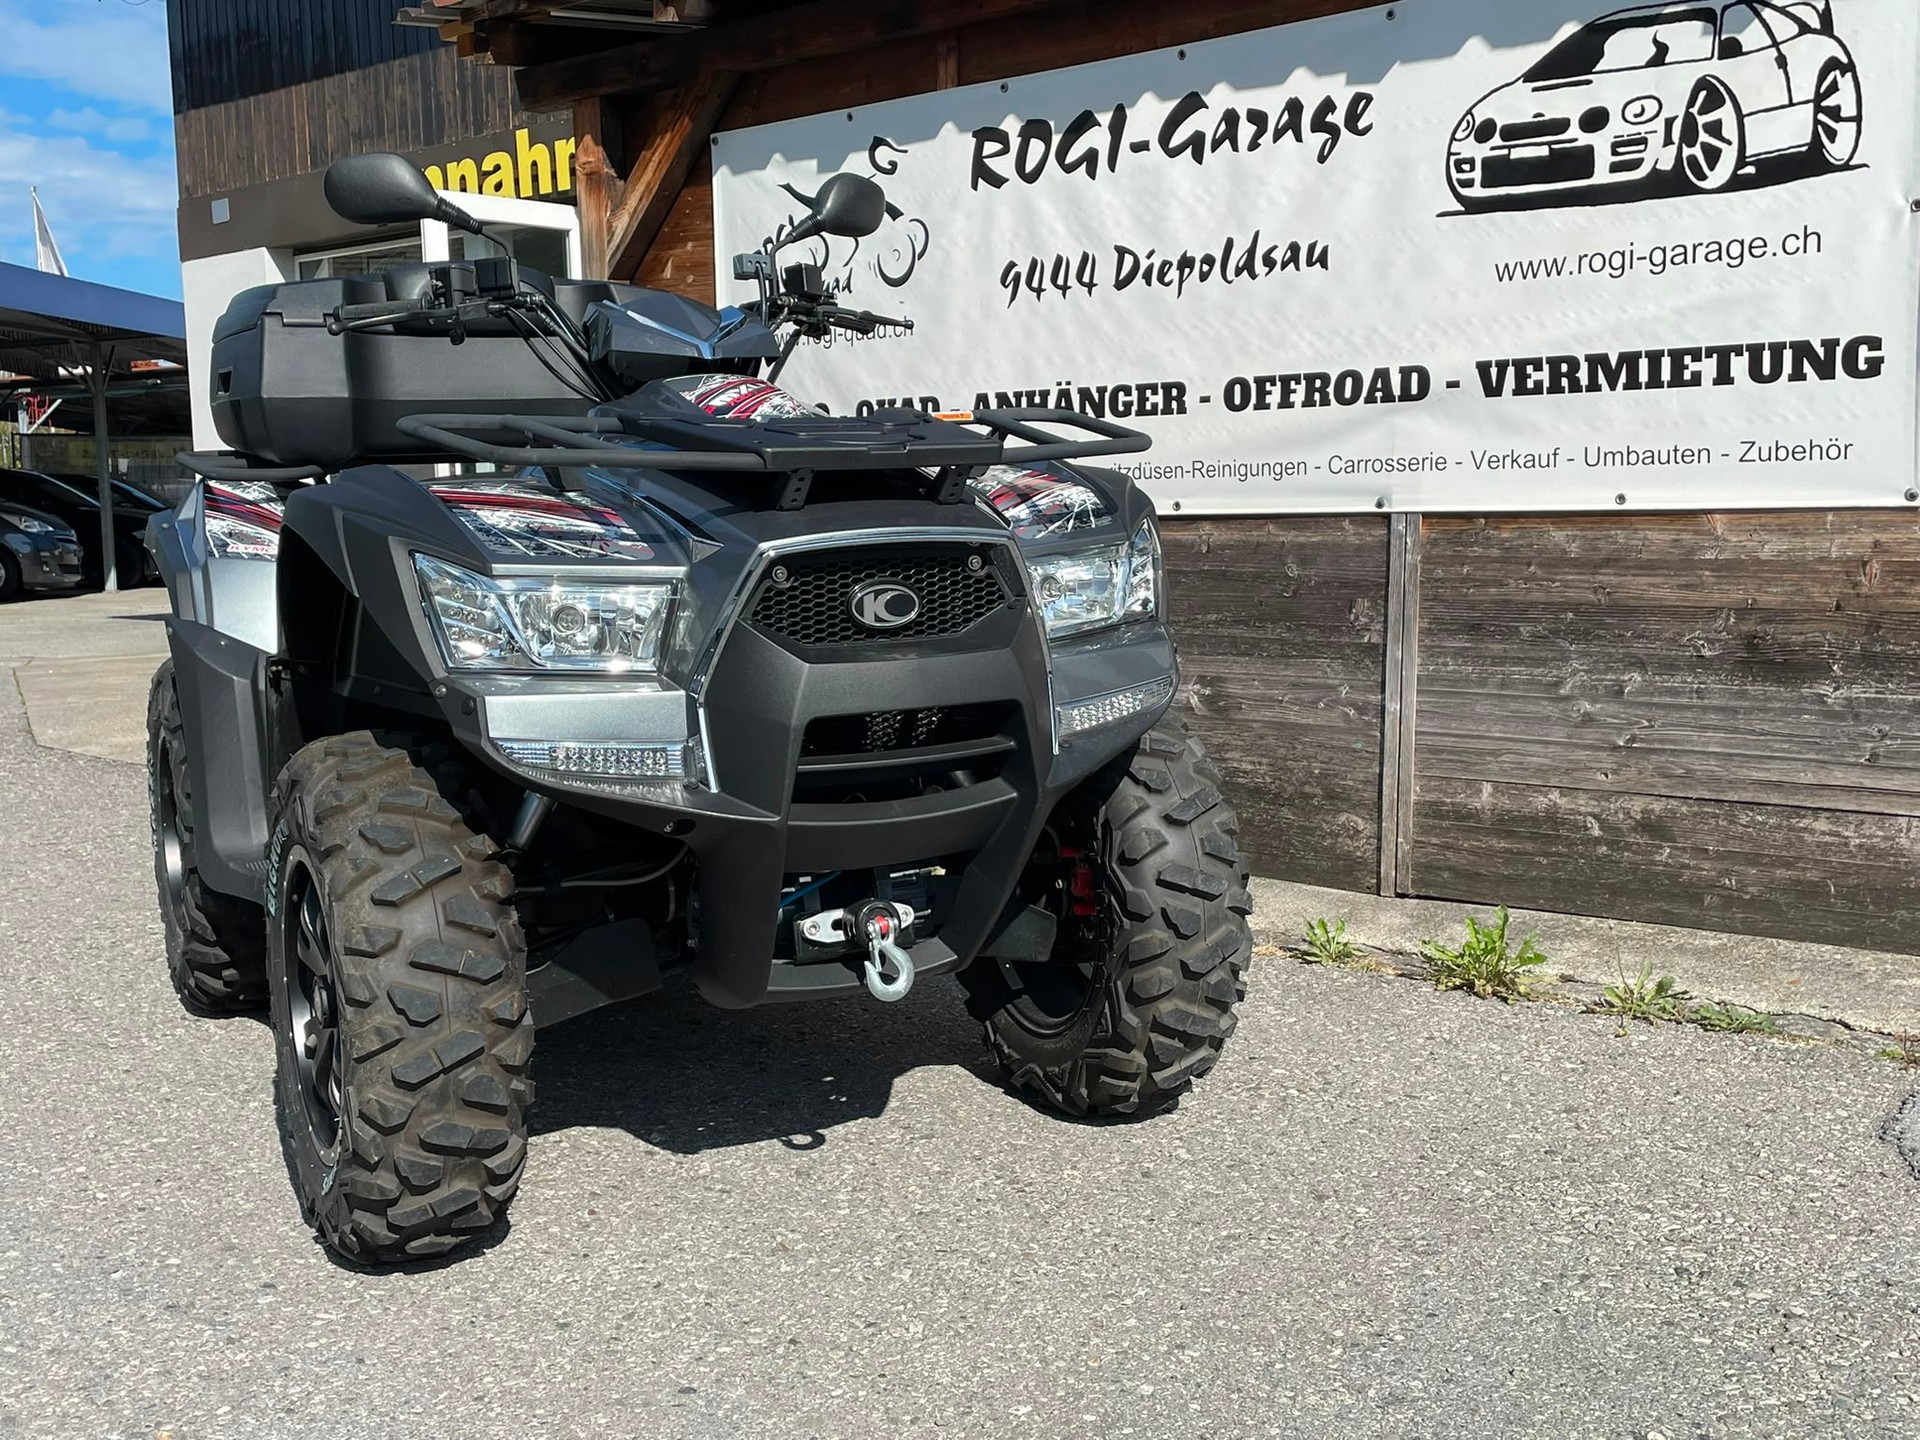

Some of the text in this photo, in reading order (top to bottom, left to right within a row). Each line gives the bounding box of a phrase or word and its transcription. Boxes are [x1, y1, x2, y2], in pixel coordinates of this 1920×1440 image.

[972, 91, 1374, 191] ROGI-Garage
[1001, 229, 1330, 308] 9444 Diepoldsau
[1494, 224, 1823, 283] www.rogi-garage.ch
[1223, 365, 1432, 413] OFFROAD
[1475, 336, 1886, 399] VERMIETUNG
[1328, 454, 1448, 475] Carrosserie
[1470, 448, 1562, 470] Verkauf
[1583, 444, 1712, 469] Umbauten
[1738, 438, 1855, 464] Zubehör
